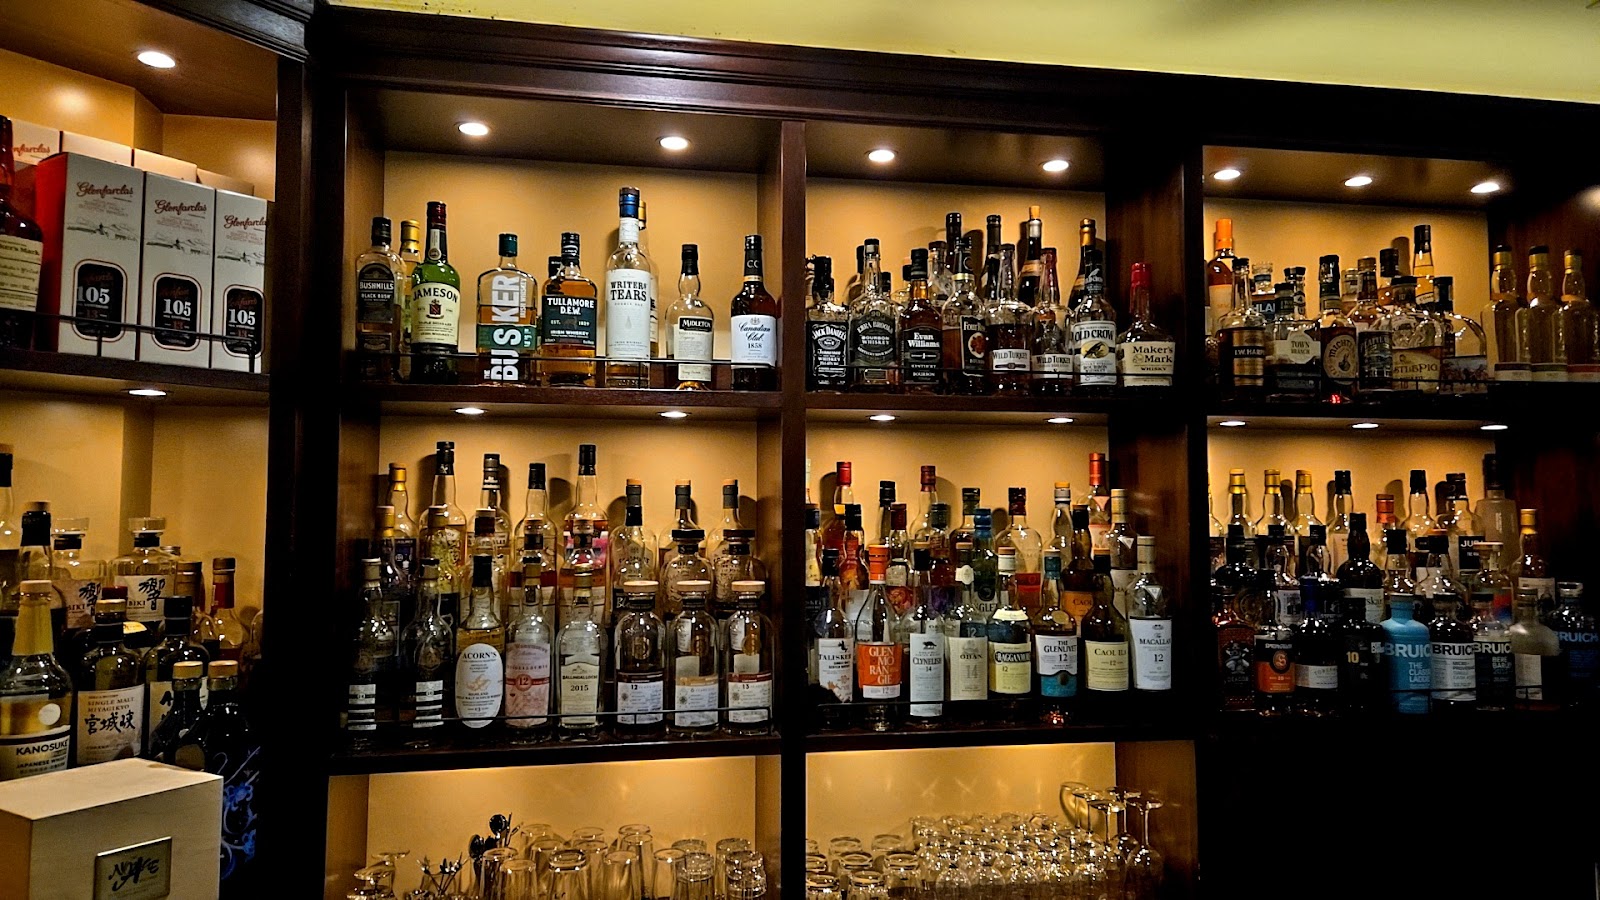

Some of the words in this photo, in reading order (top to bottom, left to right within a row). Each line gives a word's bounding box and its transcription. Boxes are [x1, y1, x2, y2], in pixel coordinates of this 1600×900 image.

[76, 181, 134, 198] Glenfarclas
[154, 199, 207, 215] Glenfarclas
[223, 214, 267, 229] Glenfarcla
[359, 280, 395, 291] BUSHMILLS
[78, 285, 111, 305] 105
[413, 287, 458, 304] JAMESON
[610, 289, 647, 302] TEARS
[163, 298, 192, 317] 105
[547, 297, 595, 309] TULLAMORE
[228, 308, 256, 326] 105
[491, 275, 521, 381] BUSKER
[682, 319, 711, 328] MIDLETON
[738, 321, 771, 332] Canadian
[812, 327, 826, 340] JACK
[913, 332, 934, 340] Evan
[1074, 329, 1091, 342] OLD
[1091, 329, 1114, 341] CROW
[907, 340, 940, 348] Williams
[993, 351, 1009, 359] WILD
[1133, 346, 1174, 354] Maker's
[1144, 354, 1173, 363] Mark
[462, 651, 498, 660] ACORN'S
[868, 647, 895, 656] GLEN
[1094, 648, 1117, 656] CAOL
[877, 656, 895, 666] MO
[1058, 654, 1068, 662] 12
[1154, 653, 1164, 662] 12
[1346, 651, 1360, 664] 10
[869, 665, 890, 675] RAN
[966, 664, 978, 679] 14
[519, 677, 529, 686] 12
[877, 674, 893, 685] GIE
[570, 684, 589, 692] 2015
[16, 738, 68, 756] KANOSUKE
[17, 760, 50, 769] JAPANESE
